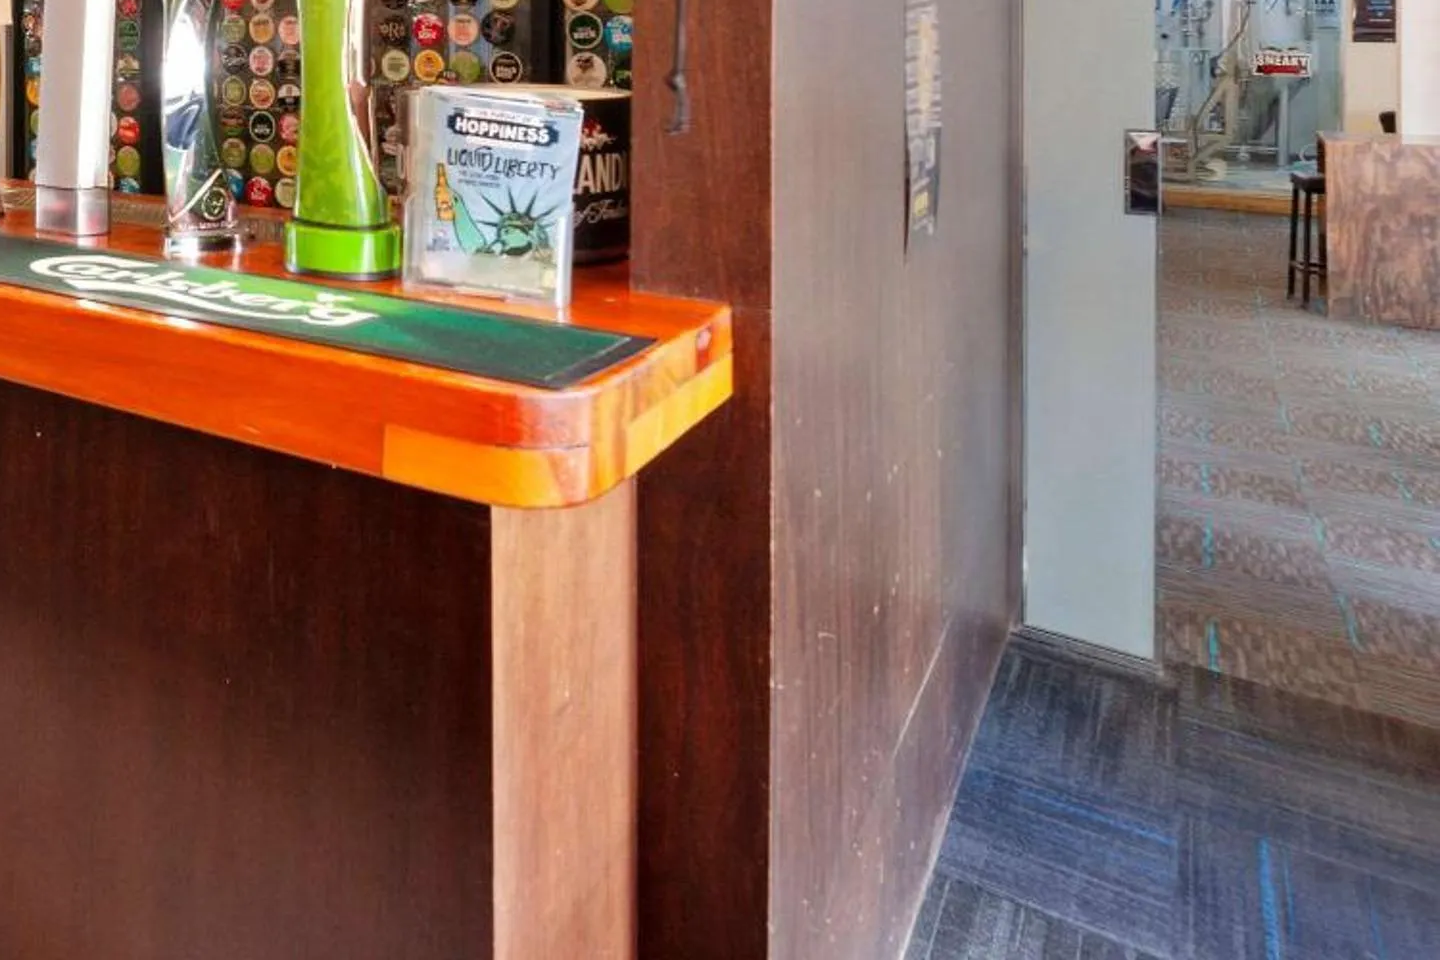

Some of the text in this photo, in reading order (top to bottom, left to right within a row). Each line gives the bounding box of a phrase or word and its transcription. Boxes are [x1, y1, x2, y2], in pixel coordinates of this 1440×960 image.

[455, 117, 550, 144] HOPPINESS
[447, 146, 492, 172] LIQUID
[494, 156, 560, 181] LIBERTY
[29, 254, 380, 327] Carlsberg
